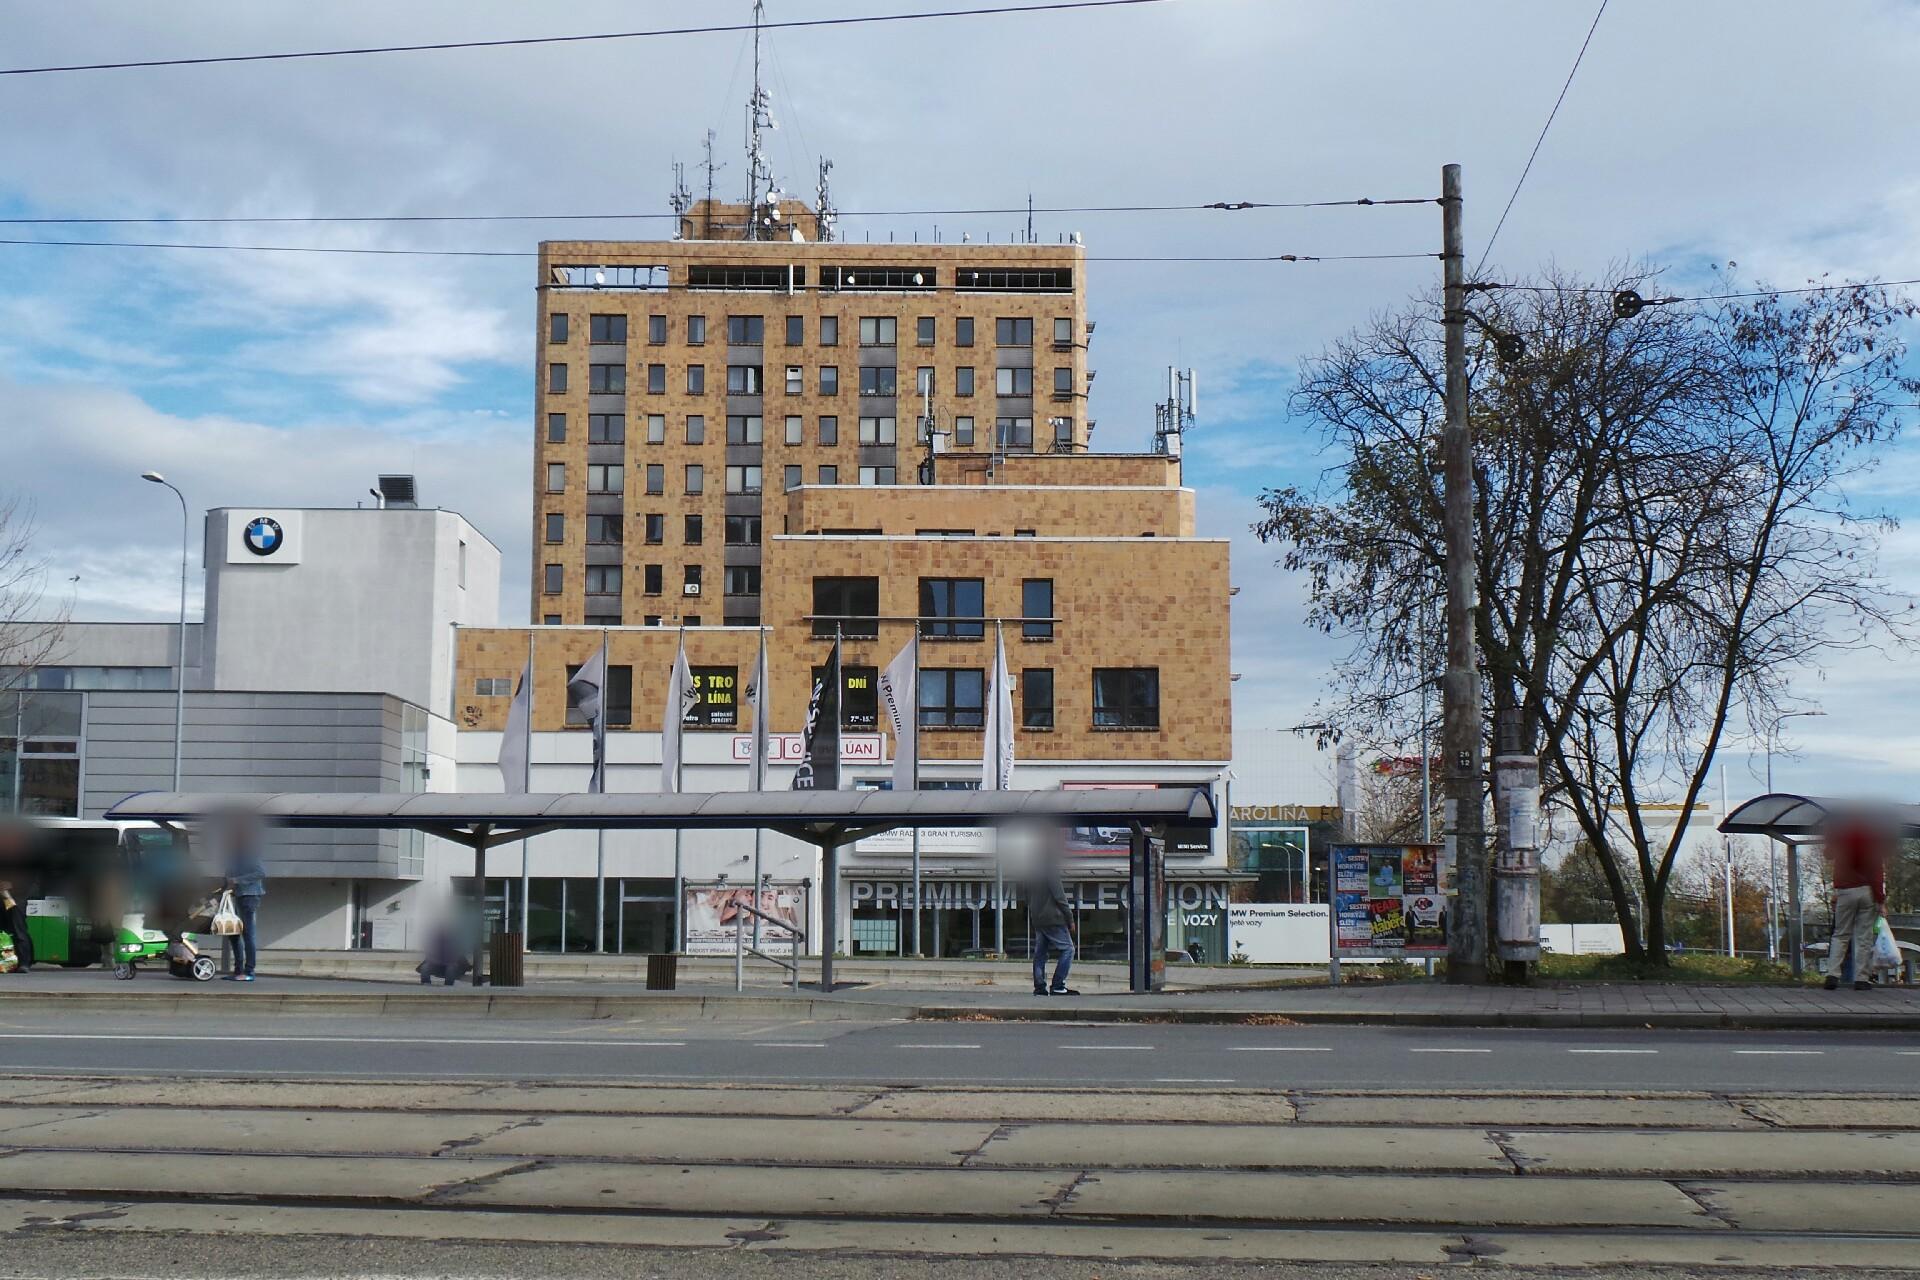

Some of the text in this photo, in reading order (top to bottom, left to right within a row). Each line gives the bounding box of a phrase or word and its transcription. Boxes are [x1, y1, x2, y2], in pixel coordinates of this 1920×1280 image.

[247, 517, 281, 531] BMW
[708, 675, 734, 689] TRO
[848, 676, 868, 689] DNÍ
[707, 690, 732, 704] LÍNA
[845, 740, 873, 755] ÚAN
[1230, 806, 1310, 821] AROLINA
[852, 882, 1017, 911] PREMIUM
[1182, 914, 1218, 926] VOZY
[1249, 909, 1286, 918] Premium
[1287, 909, 1329, 918] Selection.
